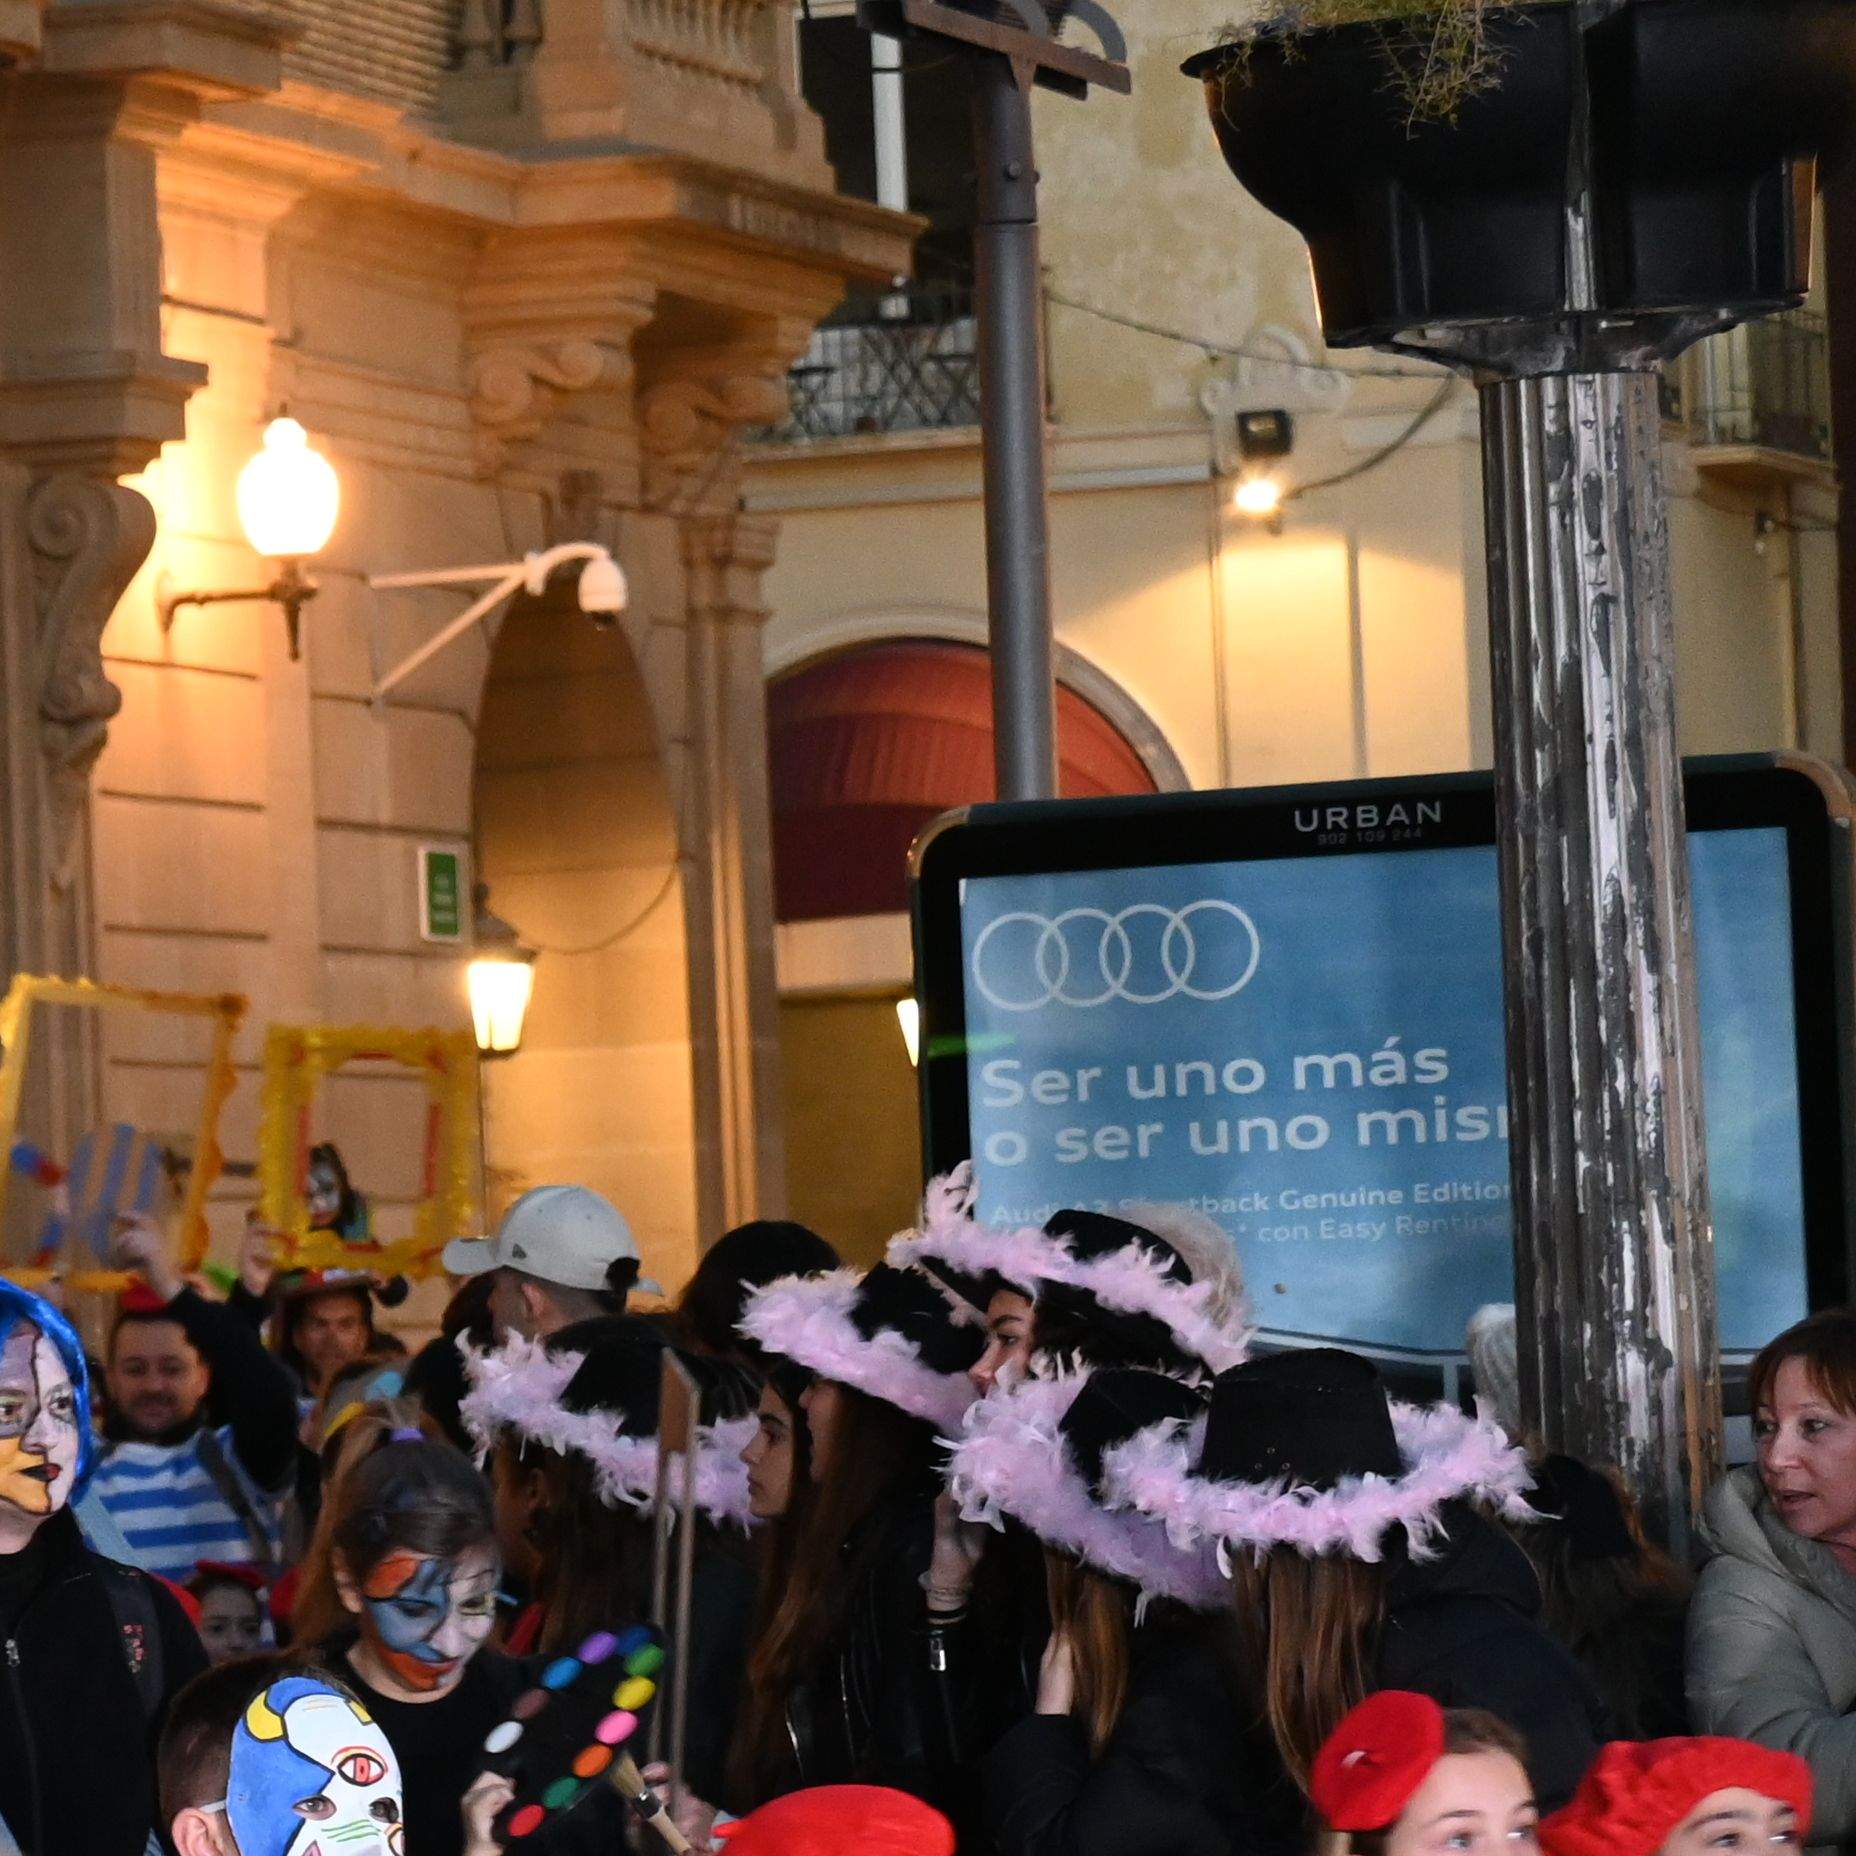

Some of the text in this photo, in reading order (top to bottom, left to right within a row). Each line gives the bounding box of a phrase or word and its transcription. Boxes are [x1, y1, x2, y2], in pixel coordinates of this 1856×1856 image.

[1294, 800, 1442, 832] URBAN
[981, 1037, 1450, 1107] Ser uno más
[983, 1096, 1509, 1167] o ser uno mis
[1278, 1187, 1403, 1211] Genuine
[1257, 1225, 1310, 1243] con
[1319, 1217, 1387, 1242] Easy
